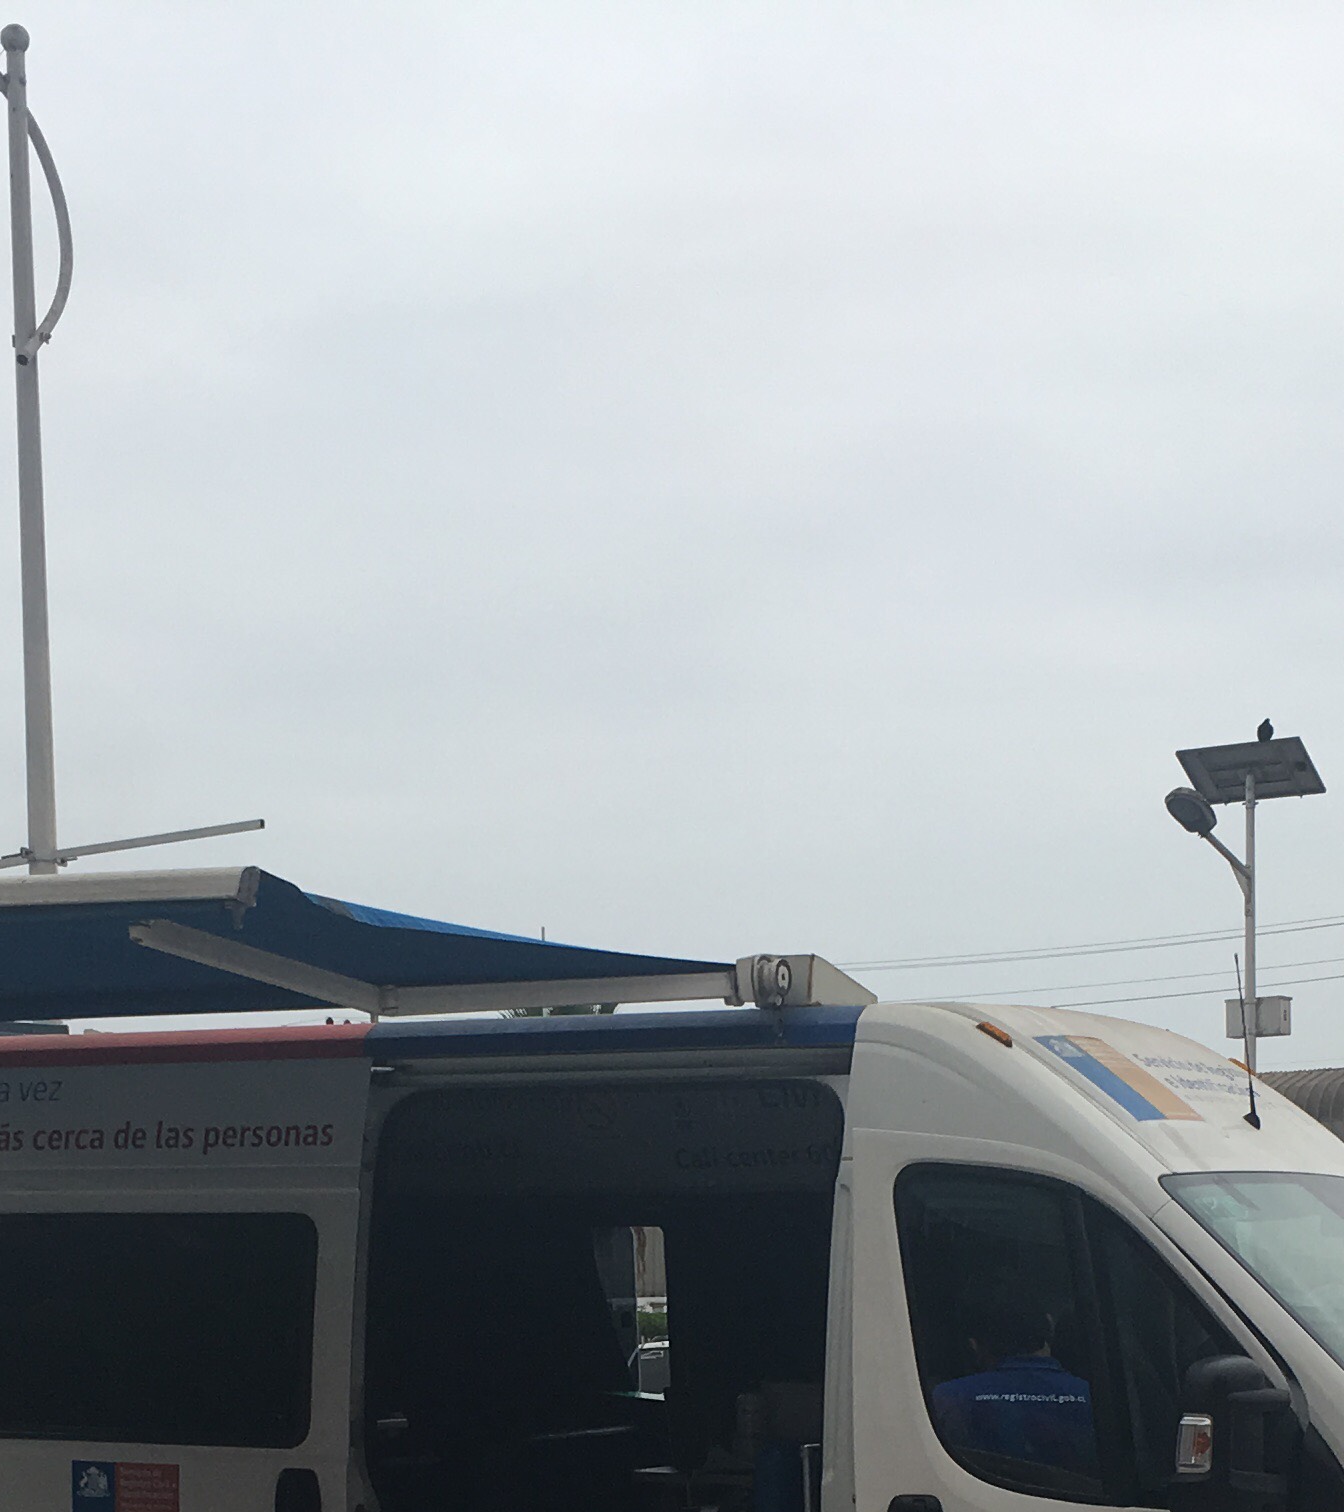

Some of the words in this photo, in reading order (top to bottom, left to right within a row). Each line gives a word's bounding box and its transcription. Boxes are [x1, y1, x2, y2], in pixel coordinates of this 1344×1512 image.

[19, 1078, 63, 1102] vez
[32, 1124, 105, 1151] cerca
[113, 1121, 148, 1149] de
[155, 1120, 194, 1149] las
[202, 1121, 334, 1155] personas
